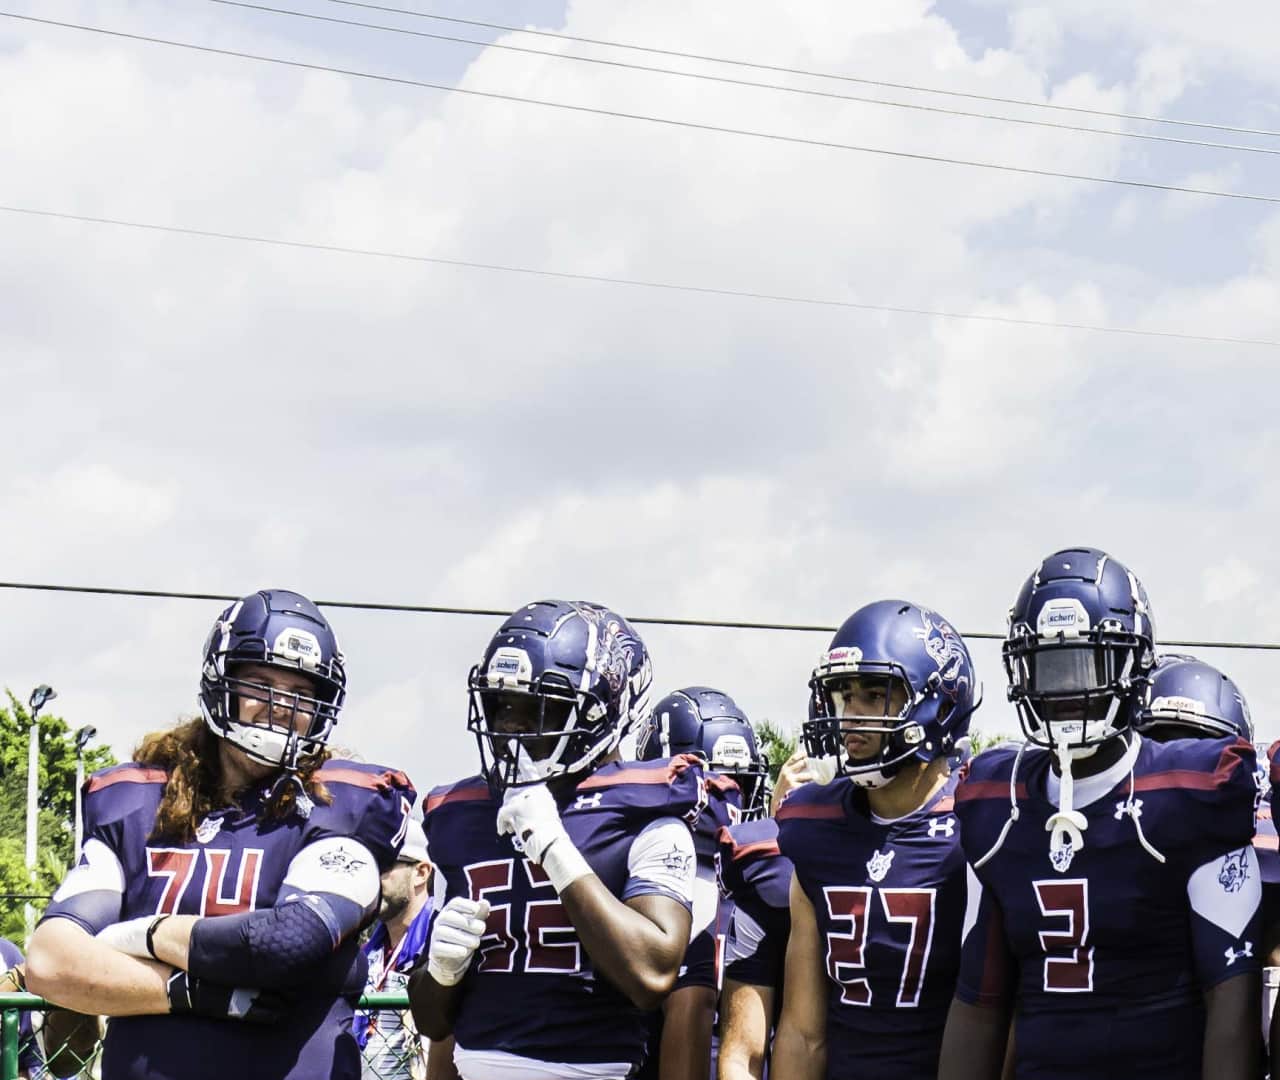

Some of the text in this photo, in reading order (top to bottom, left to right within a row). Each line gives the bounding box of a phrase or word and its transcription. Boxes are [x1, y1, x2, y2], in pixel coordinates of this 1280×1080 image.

[1048, 613, 1075, 623] schutt
[146, 846, 265, 918] 74
[823, 886, 937, 1008] 27
[1032, 878, 1095, 993] 3
